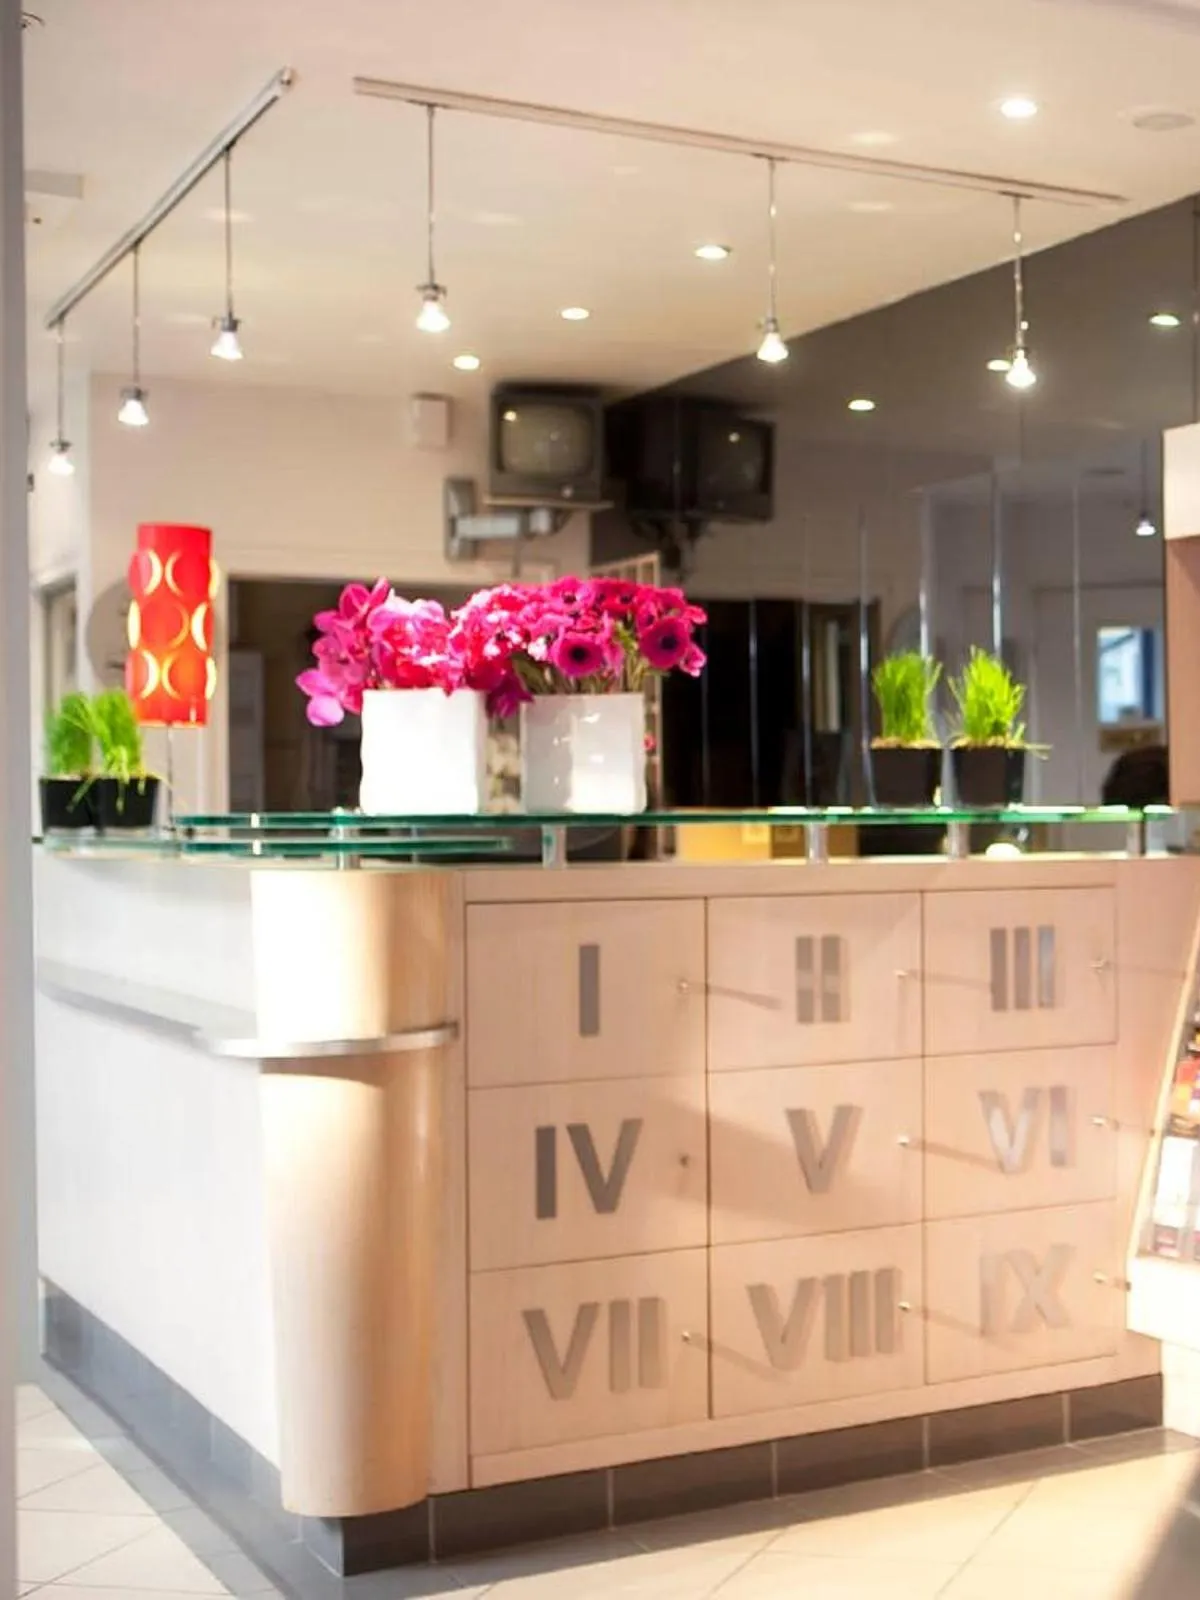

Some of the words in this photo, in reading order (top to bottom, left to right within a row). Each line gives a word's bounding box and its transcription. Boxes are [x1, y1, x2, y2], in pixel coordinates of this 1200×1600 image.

[578, 944, 600, 1037] I
[795, 934, 847, 1024] II
[989, 926, 1056, 1012] III
[534, 1117, 643, 1220] IV
[785, 1104, 862, 1194] V
[979, 1084, 1074, 1175] VI
[745, 1267, 902, 1371] VIII
[979, 1243, 1075, 1337] IX
[523, 1296, 664, 1401] VII
